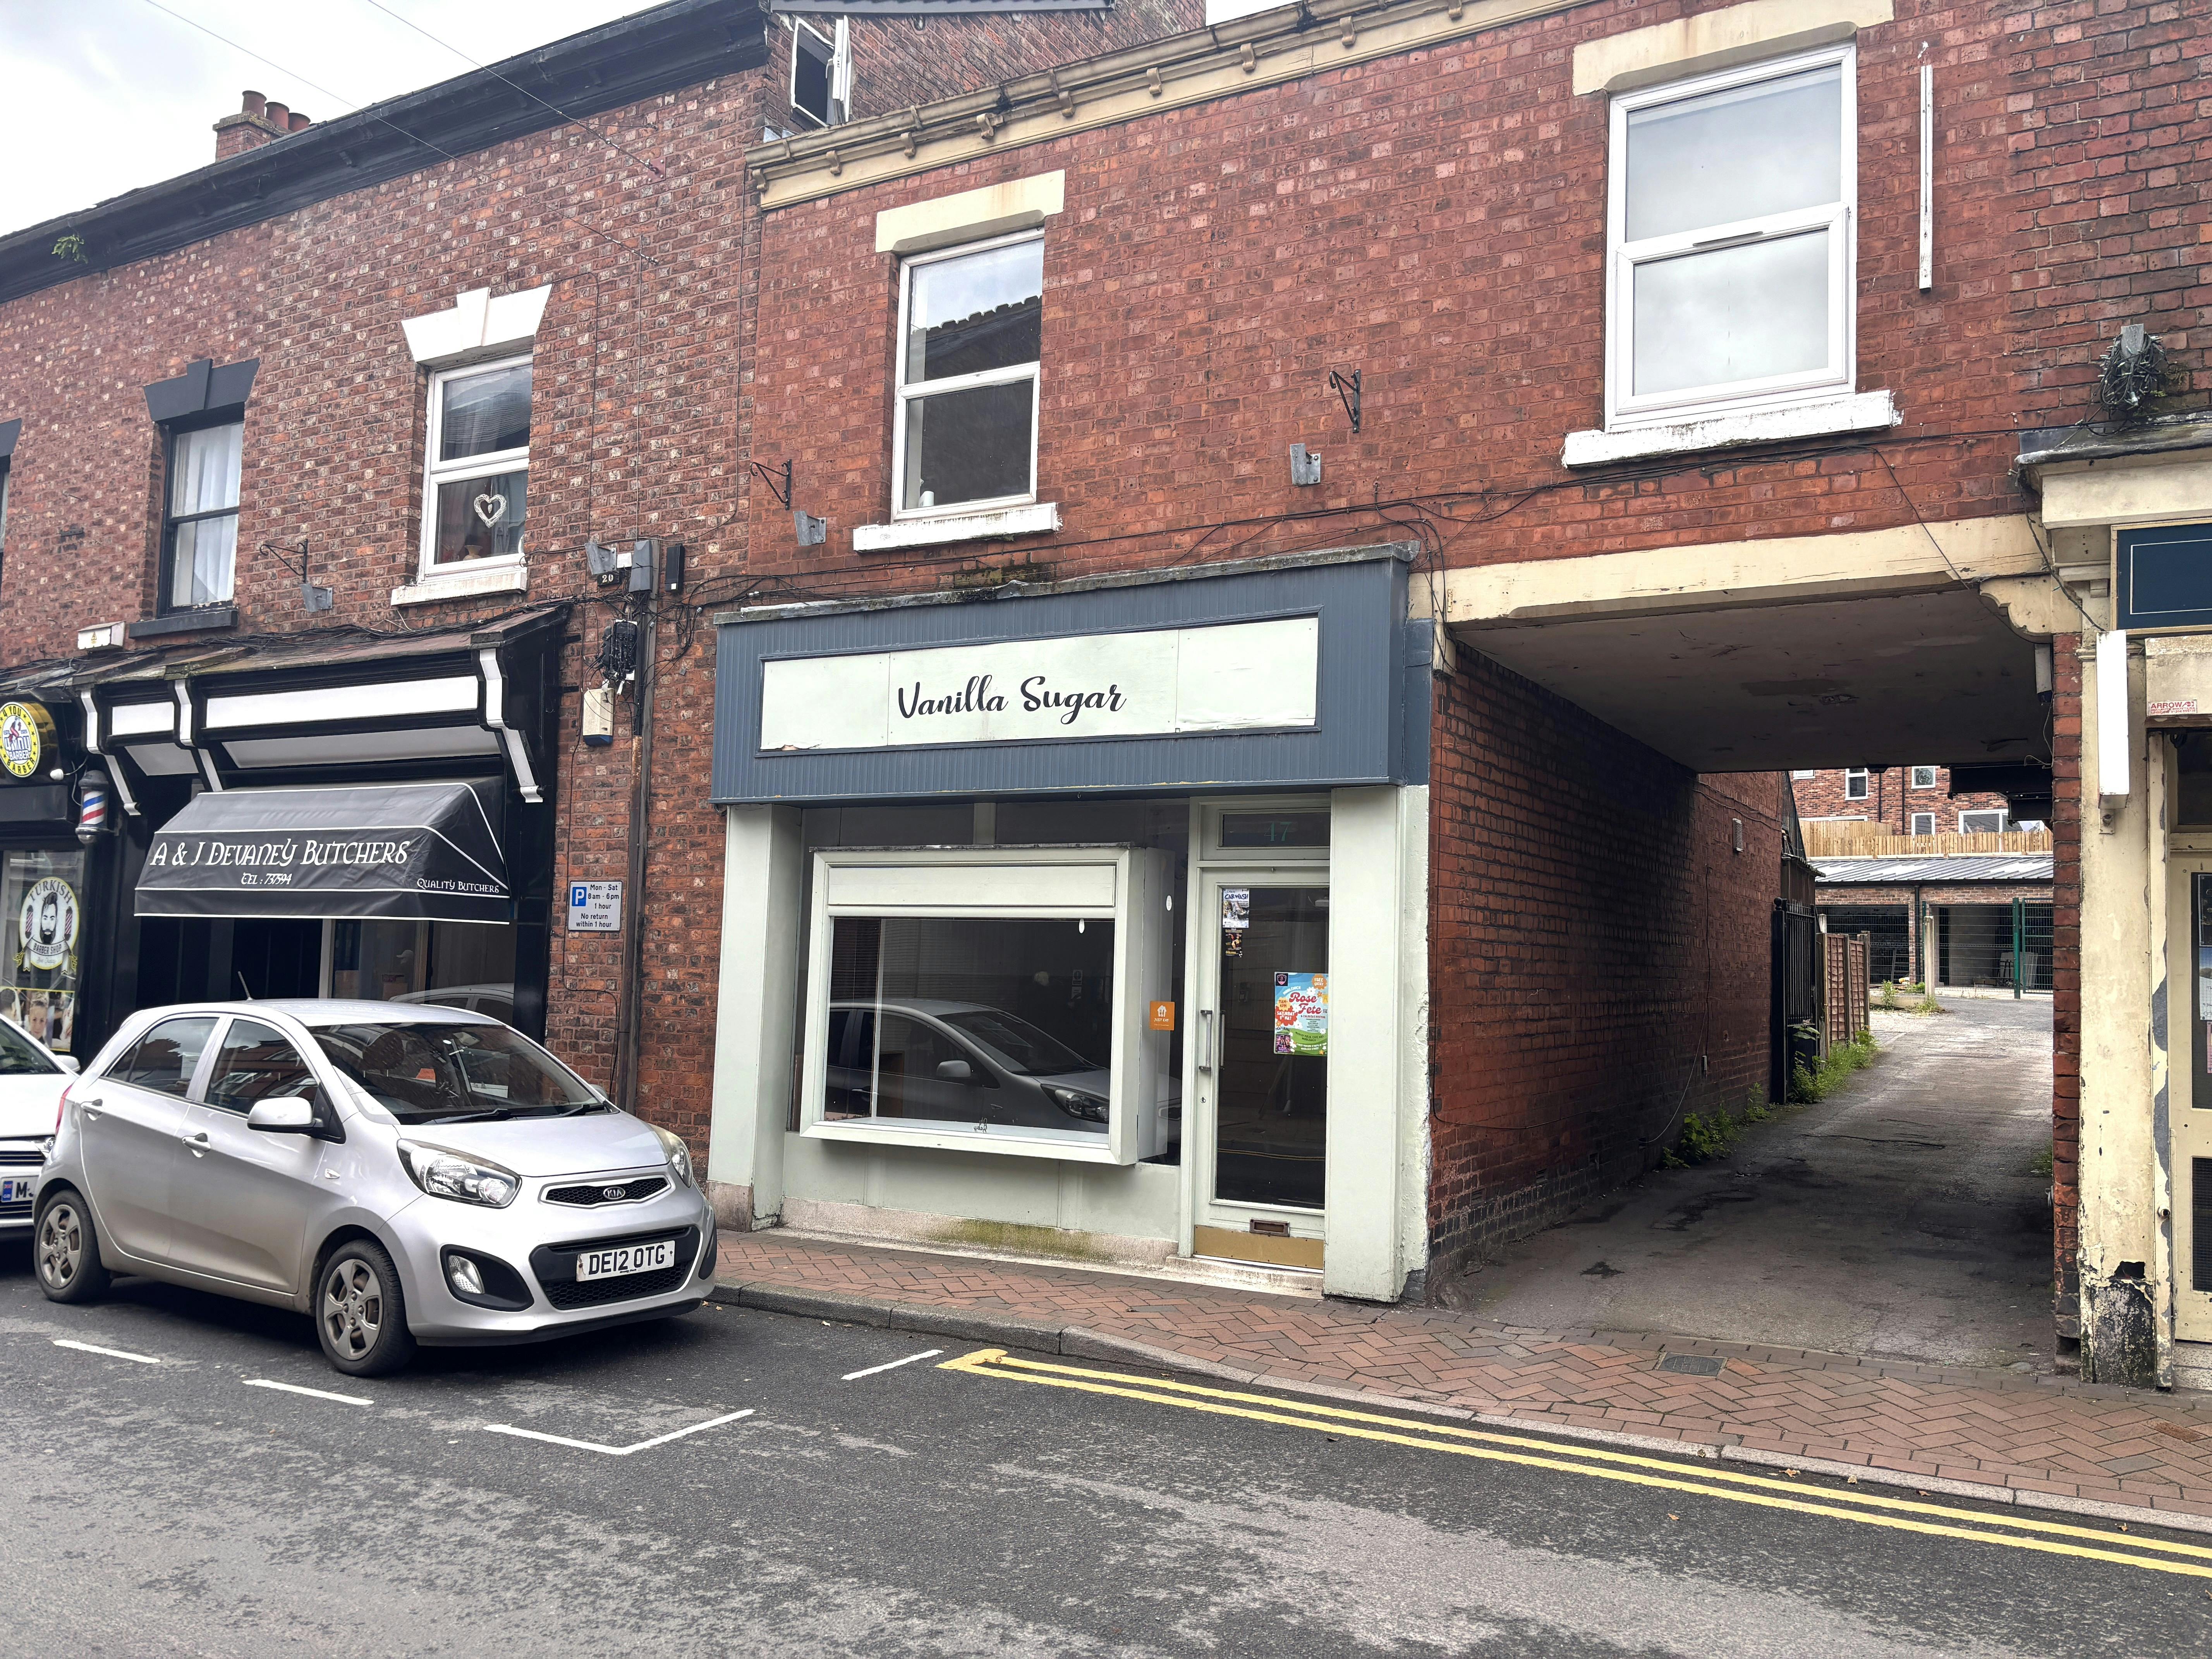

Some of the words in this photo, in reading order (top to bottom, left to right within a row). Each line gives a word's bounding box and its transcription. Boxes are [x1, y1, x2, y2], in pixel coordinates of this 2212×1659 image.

[602, 574, 613, 583] 20
[898, 675, 1008, 718] Vanilla
[1020, 676, 1127, 725] Sugar
[9, 706, 21, 717] YOU
[9, 750, 29, 761] BARBER
[7, 757, 35, 774] BARBER
[1264, 821, 1293, 842] 47
[149, 842, 167, 866] A
[172, 842, 187, 866] &
[191, 842, 206, 866] J
[205, 838, 298, 866] DEVANEY
[300, 840, 410, 866] BUTCHERS
[264, 873, 292, 884] 737594
[417, 878, 455, 890] QUALITY
[458, 881, 499, 893] BUTCHERS
[29, 880, 72, 903] TURKISH
[575, 889, 584, 905] P
[33, 943, 49, 954] BARBER
[50, 944, 62, 954] SHOP
[1289, 992, 1317, 1003] Rose
[1298, 1003, 1322, 1014] Fete
[589, 1250, 629, 1275] DE12
[634, 1245, 665, 1268] OTG
